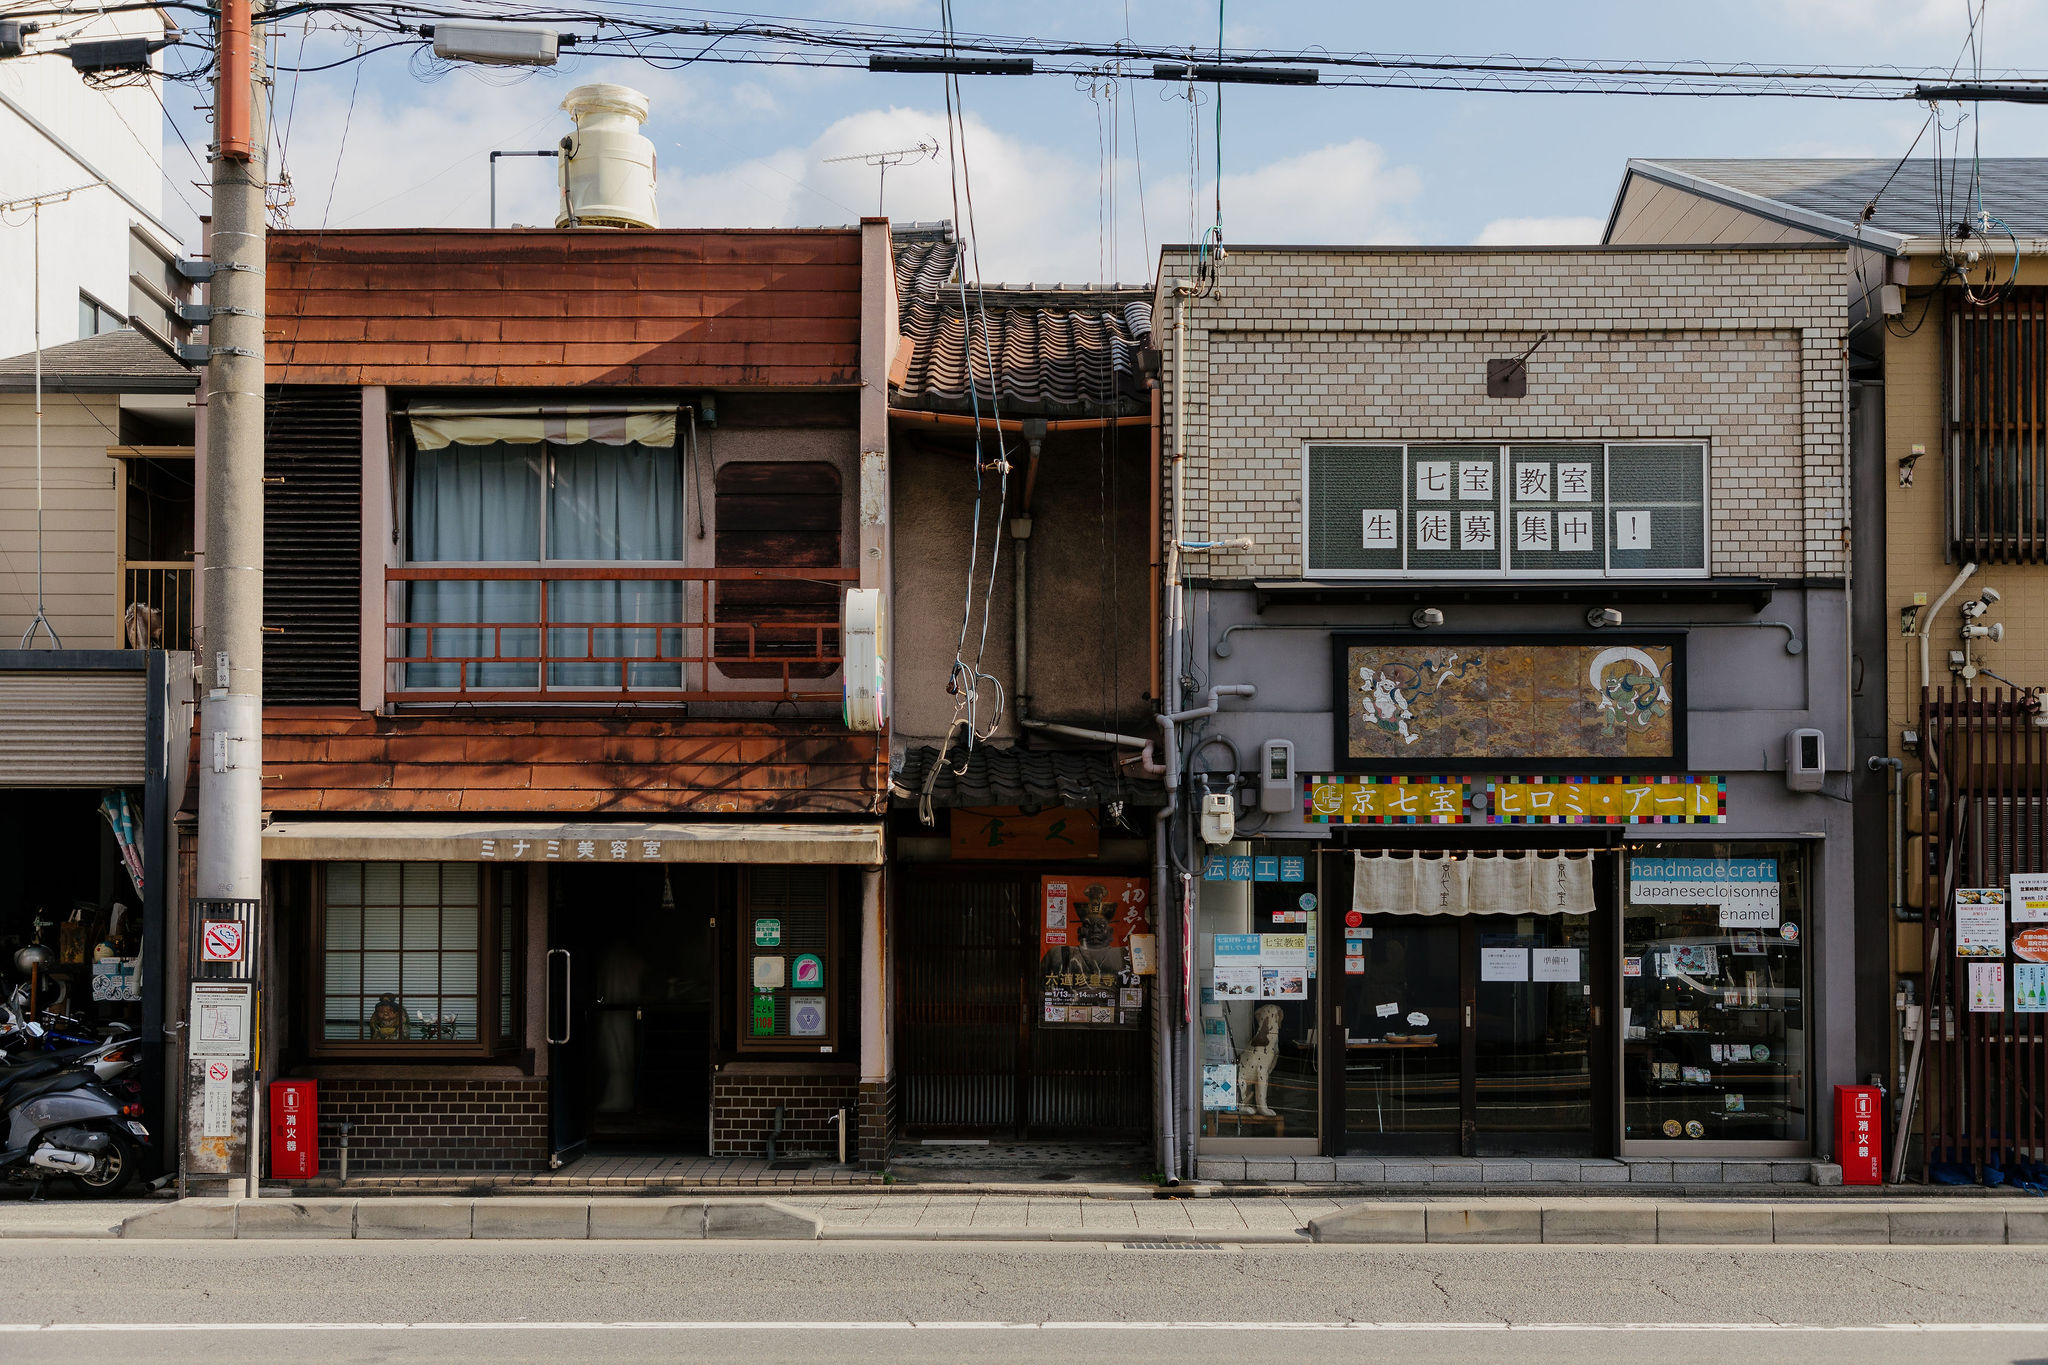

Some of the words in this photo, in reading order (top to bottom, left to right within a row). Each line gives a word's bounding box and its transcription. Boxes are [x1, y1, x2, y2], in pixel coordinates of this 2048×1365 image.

[1420, 466, 1588, 496] 七宝教室
[1350, 785, 1456, 814] 京七宝
[1500, 785, 1710, 814] ヒロミ・アート
[480, 839, 661, 859] ミナミ美容室
[1207, 858, 1302, 878] 伝統工芸
[1632, 861, 1726, 877] handmade
[1728, 861, 1774, 877] craft
[1440, 864, 1451, 907] 京七宝
[1557, 863, 1567, 906] 京七宝
[1720, 907, 1774, 920] enamel
[1264, 937, 1305, 947] 七宝教室
[1045, 973, 1116, 987] 六道珍皇寺
[756, 1005, 773, 1013] こども
[286, 1114, 297, 1151] 消火器
[1858, 1120, 1869, 1157] 消火器
